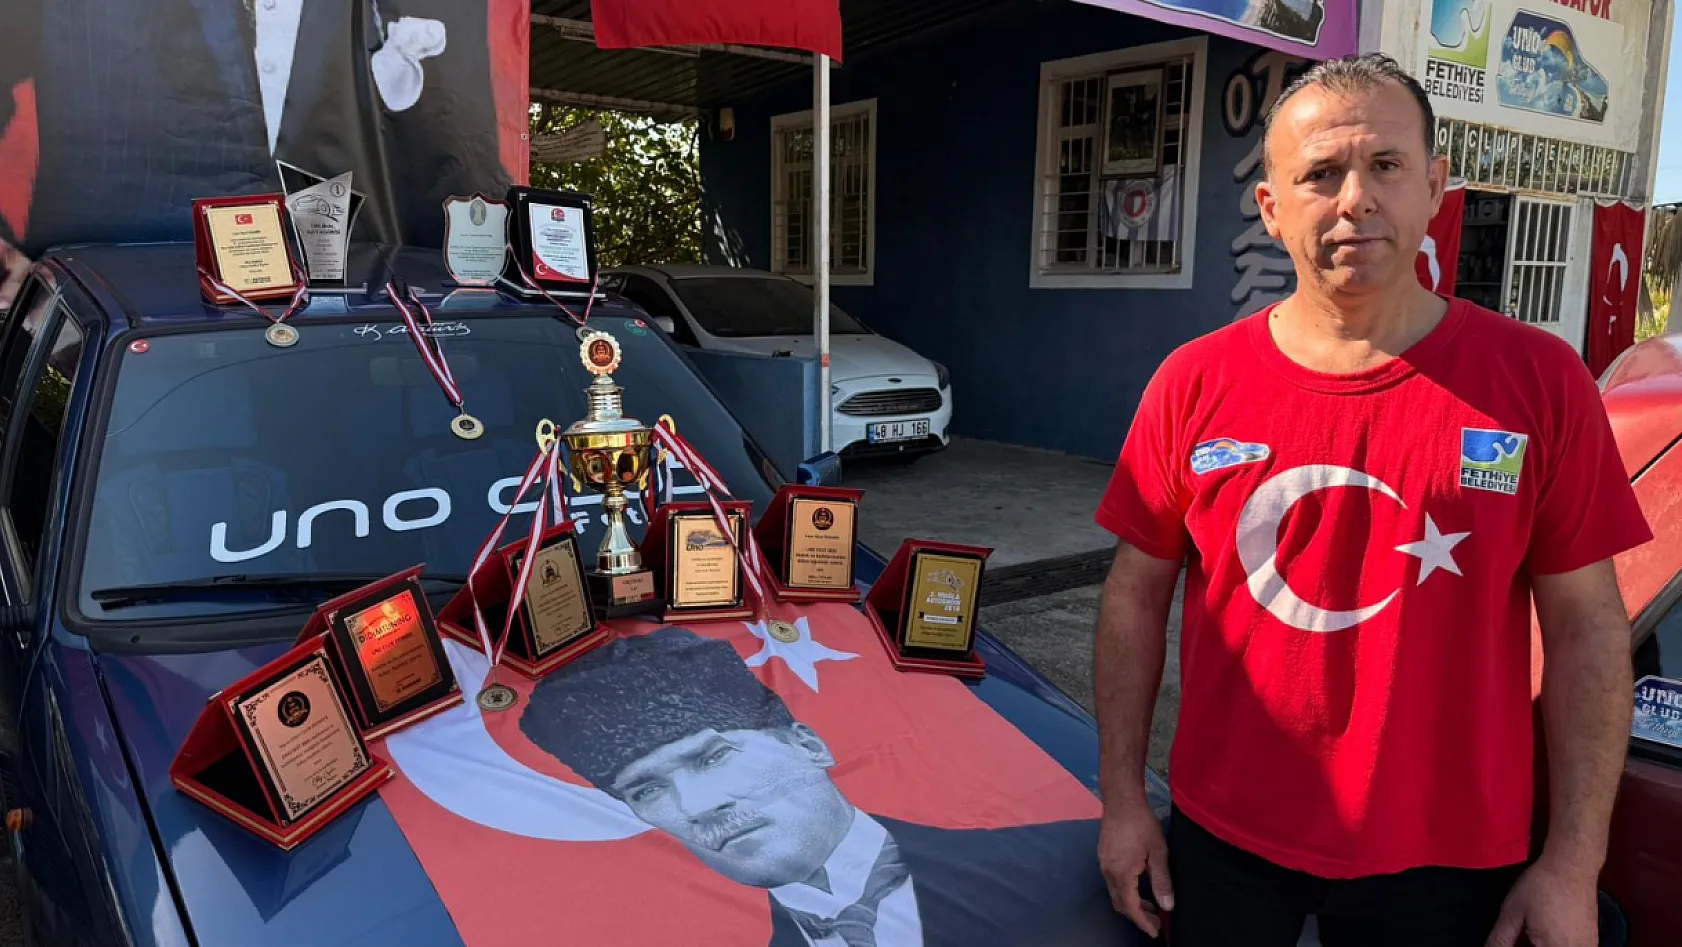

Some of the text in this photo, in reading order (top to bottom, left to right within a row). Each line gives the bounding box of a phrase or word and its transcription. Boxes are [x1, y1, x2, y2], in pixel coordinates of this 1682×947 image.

[875, 420, 928, 439] 48 HJ 166
